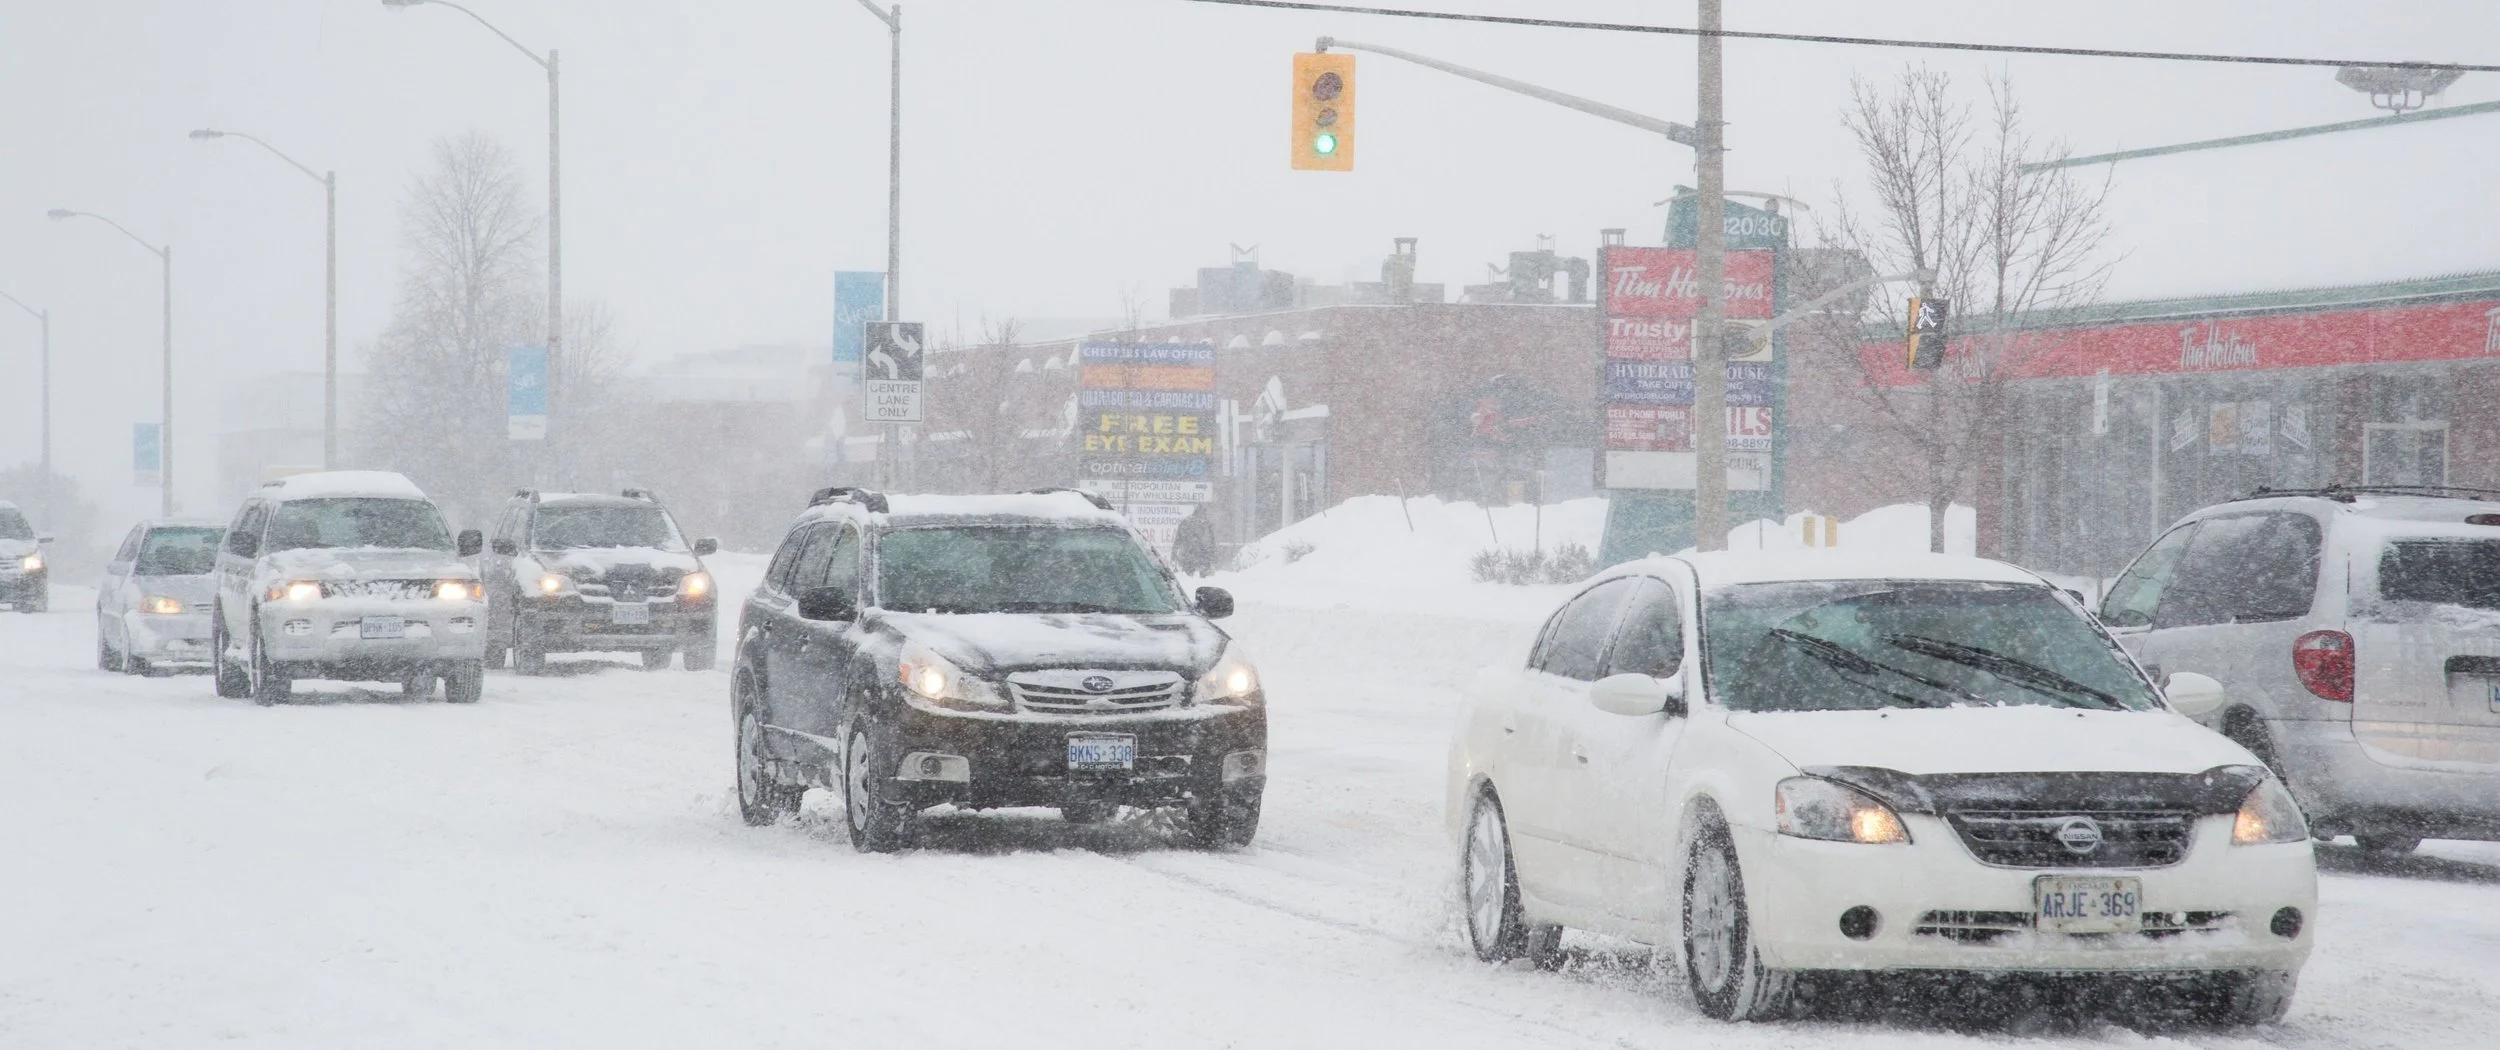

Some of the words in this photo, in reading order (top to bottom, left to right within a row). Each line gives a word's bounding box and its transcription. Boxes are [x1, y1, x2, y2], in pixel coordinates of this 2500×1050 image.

[1724, 214, 1782, 238] 20/30
[1612, 266, 1662, 298] Tim
[1666, 266, 1764, 299] Hoons
[1609, 319, 1687, 343] Trusty
[2485, 307, 2500, 354] Ti
[2180, 327, 2200, 368] Tim
[2204, 320, 2258, 367] Hortons
[1143, 350, 1169, 360] LAW
[1171, 350, 1214, 360] OFFICE
[1726, 365, 1766, 380] OUSE
[870, 384, 918, 393] CENTRE
[1637, 381, 1661, 390] TAKE
[1664, 381, 1684, 390] OUT
[878, 395, 910, 405] LANE
[1195, 393, 1213, 409] LAB
[878, 407, 909, 417] ONLY
[1608, 409, 1626, 418] CELL
[1629, 409, 1655, 418] PHONE
[1657, 410, 1685, 420] WORLD
[1101, 414, 1199, 434] FREE
[1138, 436, 1213, 454] EXAM
[1112, 481, 1181, 491] METROPOLITAN
[1143, 492, 1205, 500] WHOLESALER
